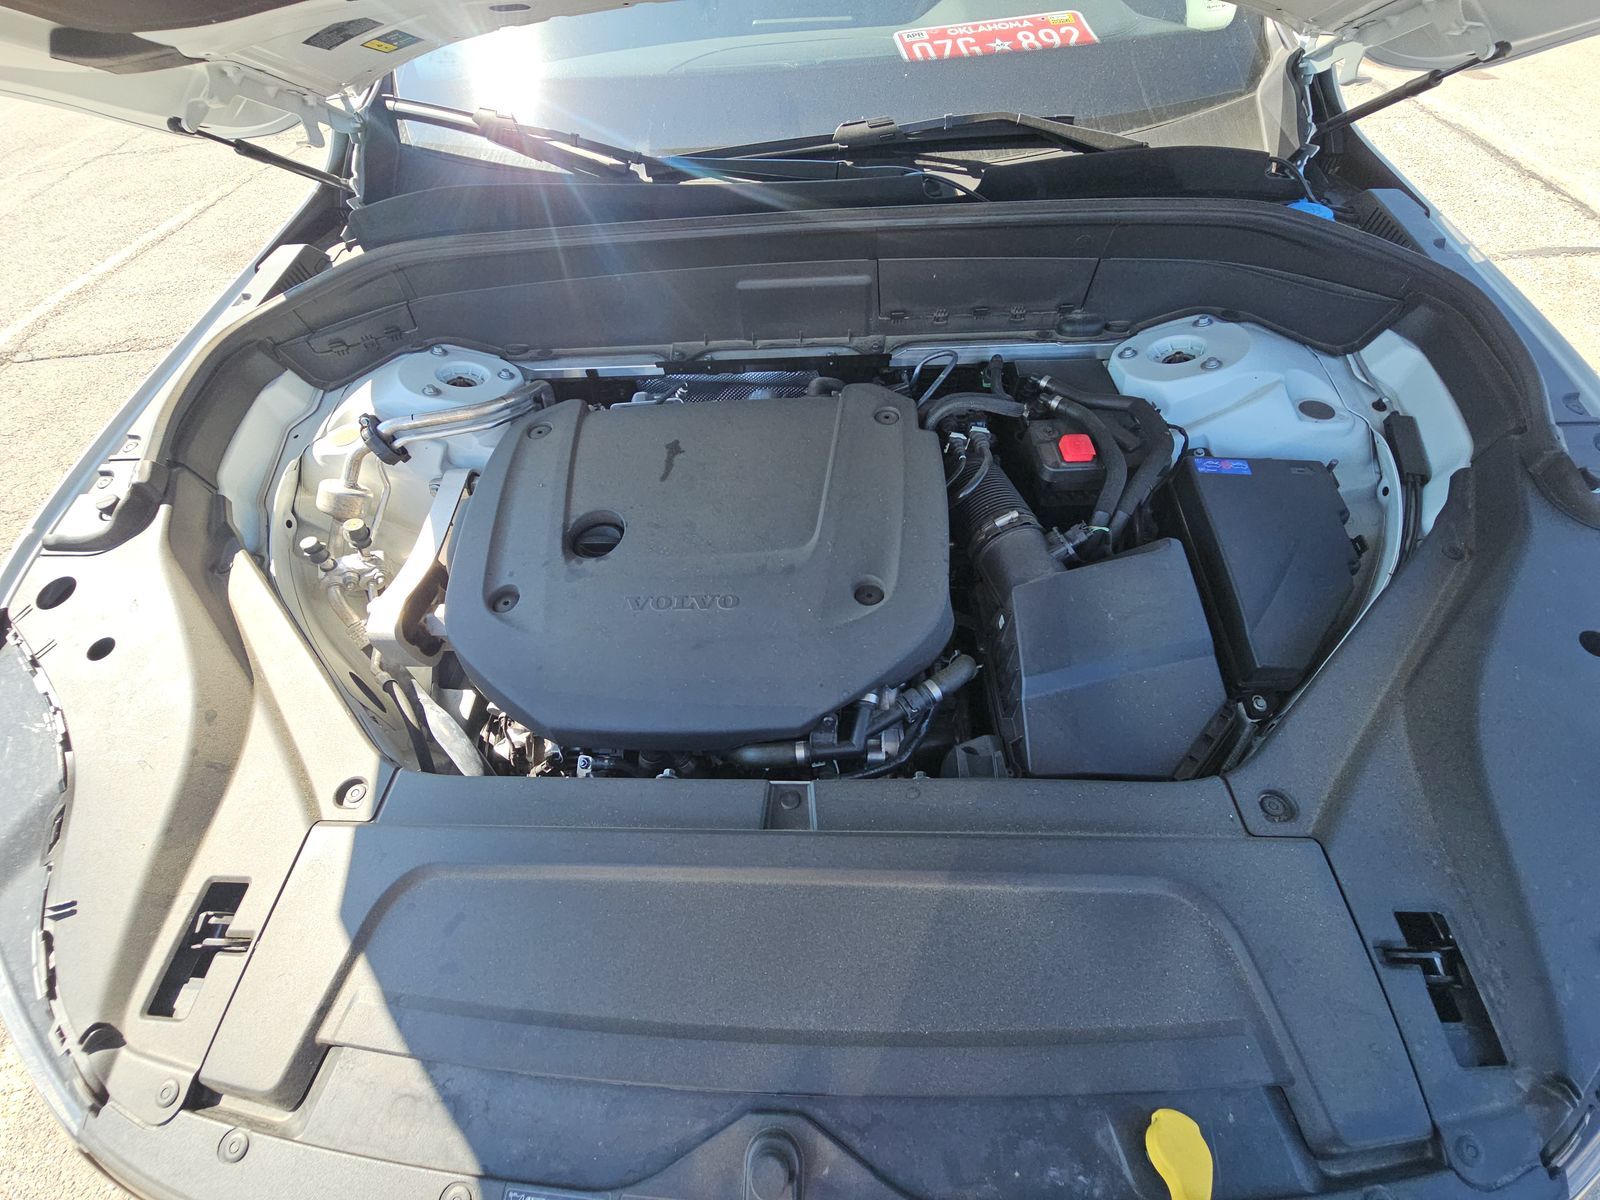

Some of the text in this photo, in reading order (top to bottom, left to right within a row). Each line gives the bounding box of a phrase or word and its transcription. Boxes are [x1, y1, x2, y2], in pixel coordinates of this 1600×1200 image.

[906, 31, 925, 39] APR
[946, 20, 1034, 36] OKLAHOMA
[1016, 26, 1080, 51] 892
[624, 593, 740, 612] VOLVO
